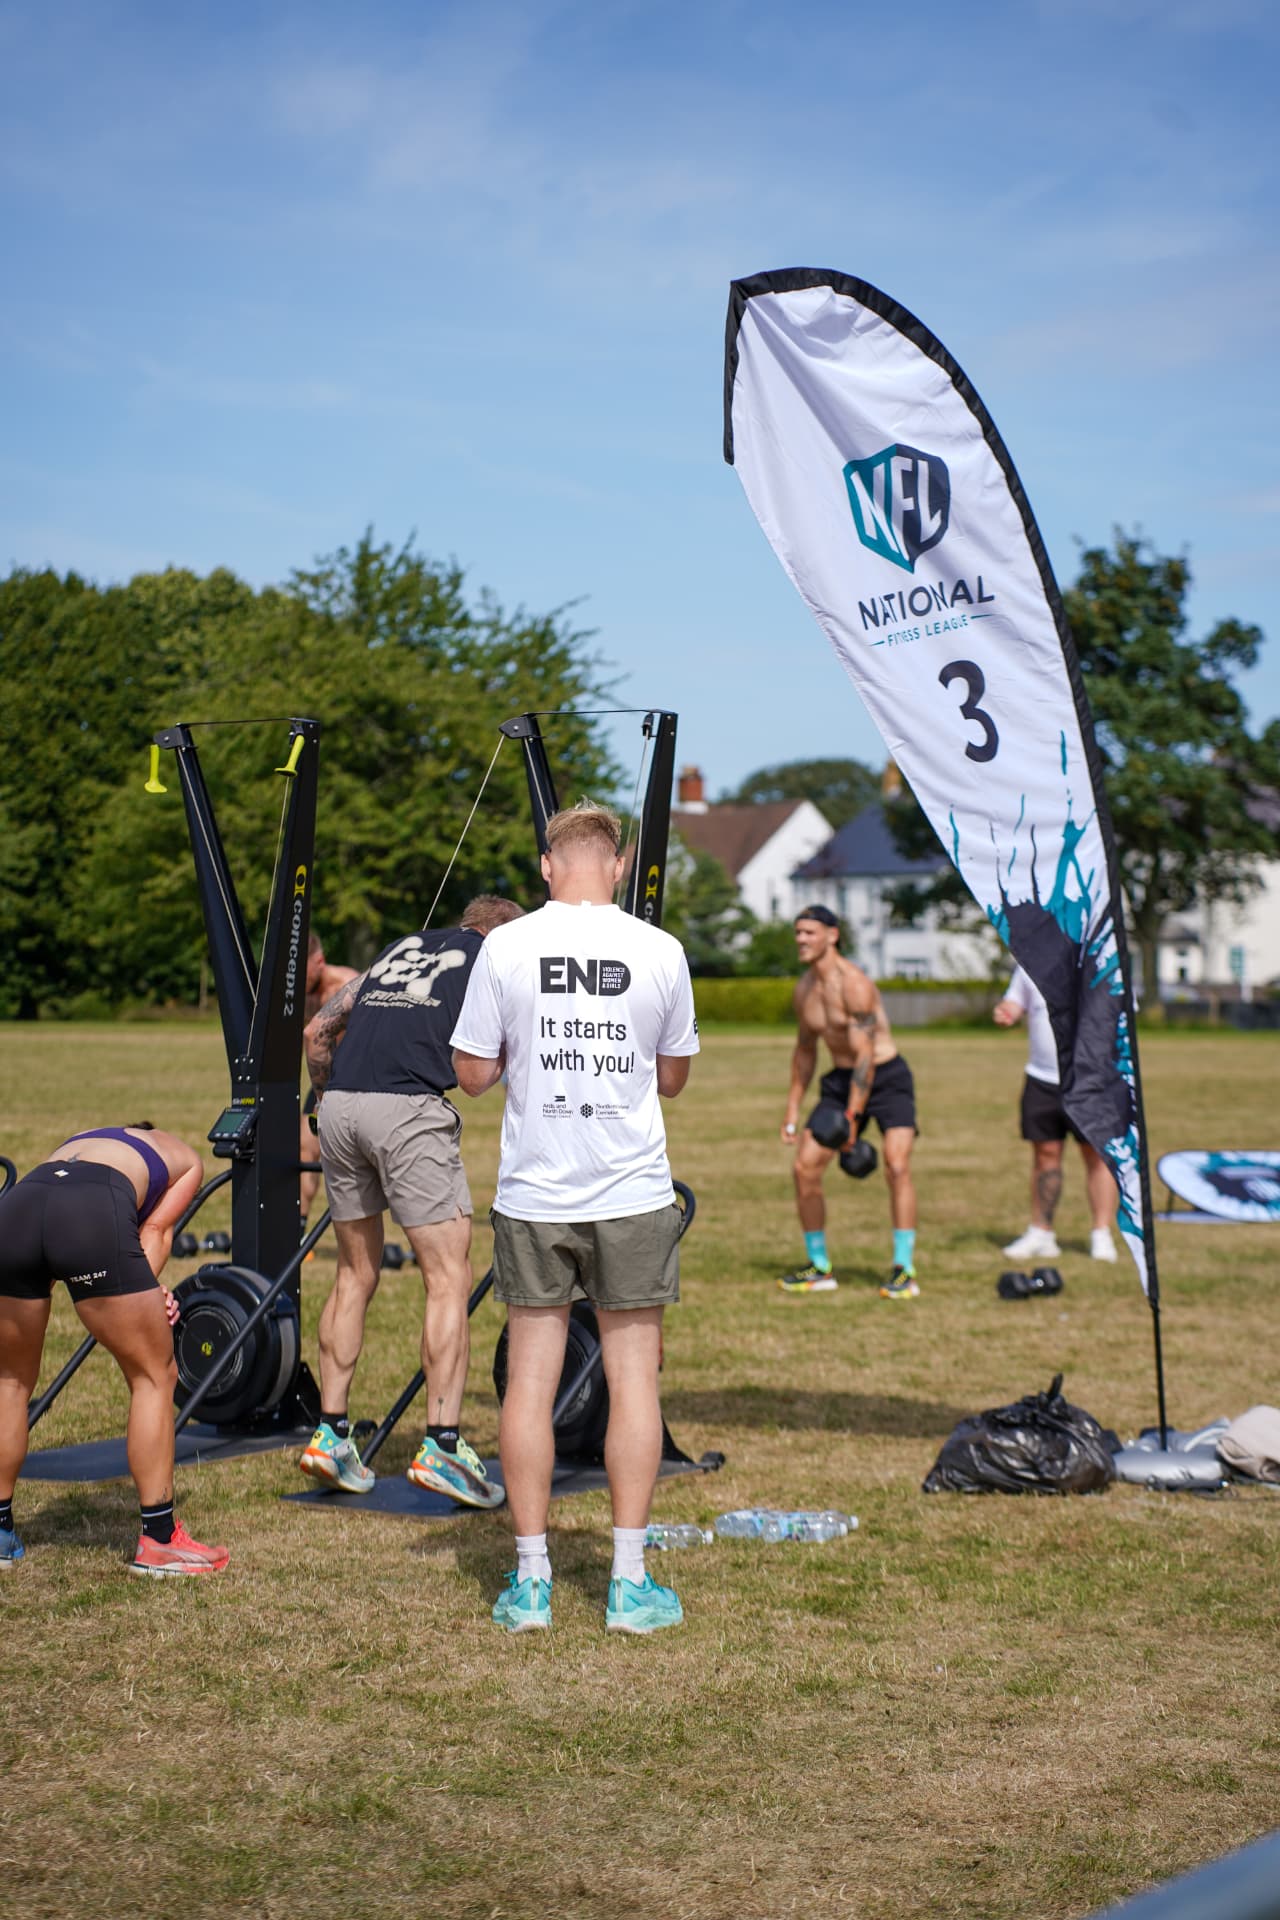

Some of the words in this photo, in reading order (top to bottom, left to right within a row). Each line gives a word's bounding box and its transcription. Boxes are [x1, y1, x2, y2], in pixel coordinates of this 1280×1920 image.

[849, 454, 942, 562] NFL
[857, 575, 996, 631] NATIONAL
[887, 627, 920, 647] FIESS
[938, 659, 999, 763] 3
[285, 899, 303, 998] concept
[540, 956, 631, 996] END
[283, 1002, 294, 1016] 2
[541, 1016, 556, 1039] It
[563, 1018, 627, 1042] starts
[540, 1048, 585, 1072] with
[592, 1052, 635, 1077] you!
[70, 1273, 91, 1282] TEAM
